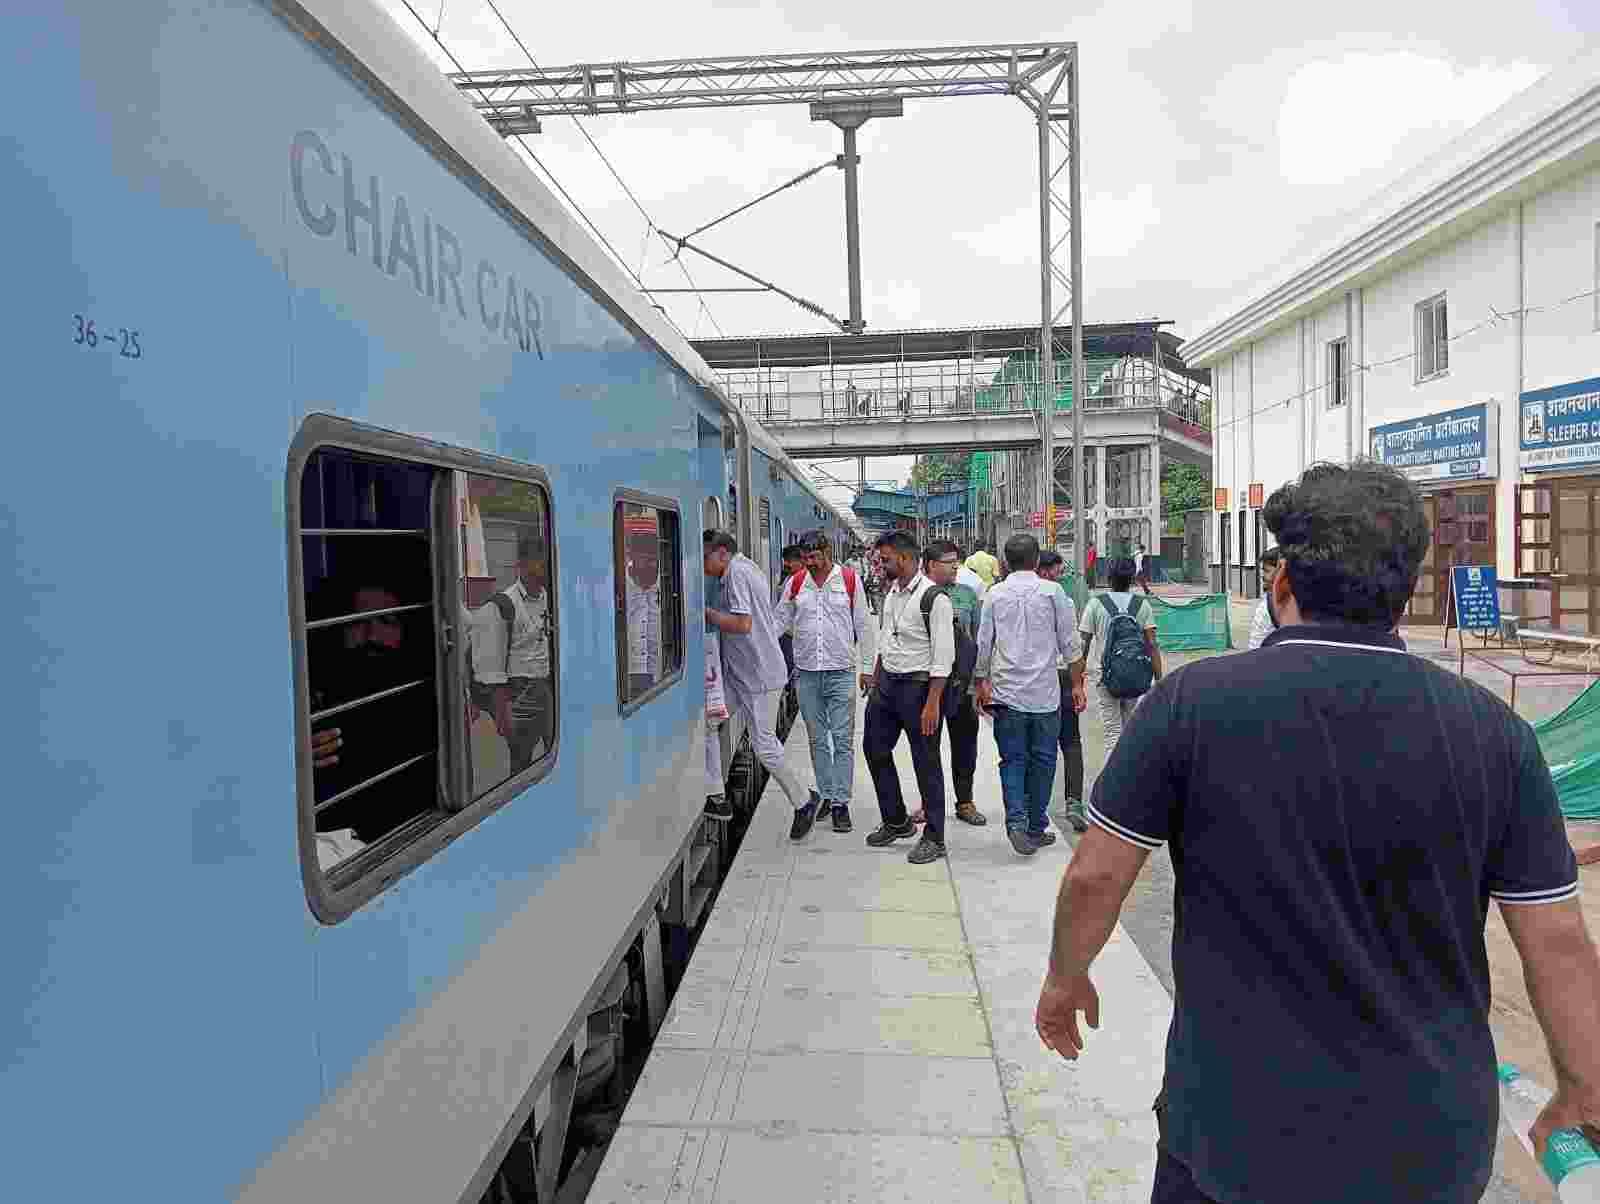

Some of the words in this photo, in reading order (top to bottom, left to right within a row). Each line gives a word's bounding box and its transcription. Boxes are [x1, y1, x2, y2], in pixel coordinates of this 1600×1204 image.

[290, 130, 466, 320] CHAIR
[477, 260, 542, 360] CAR
[1548, 422, 1587, 442] SLEEPER
[1461, 440, 1480, 457] ROOM
